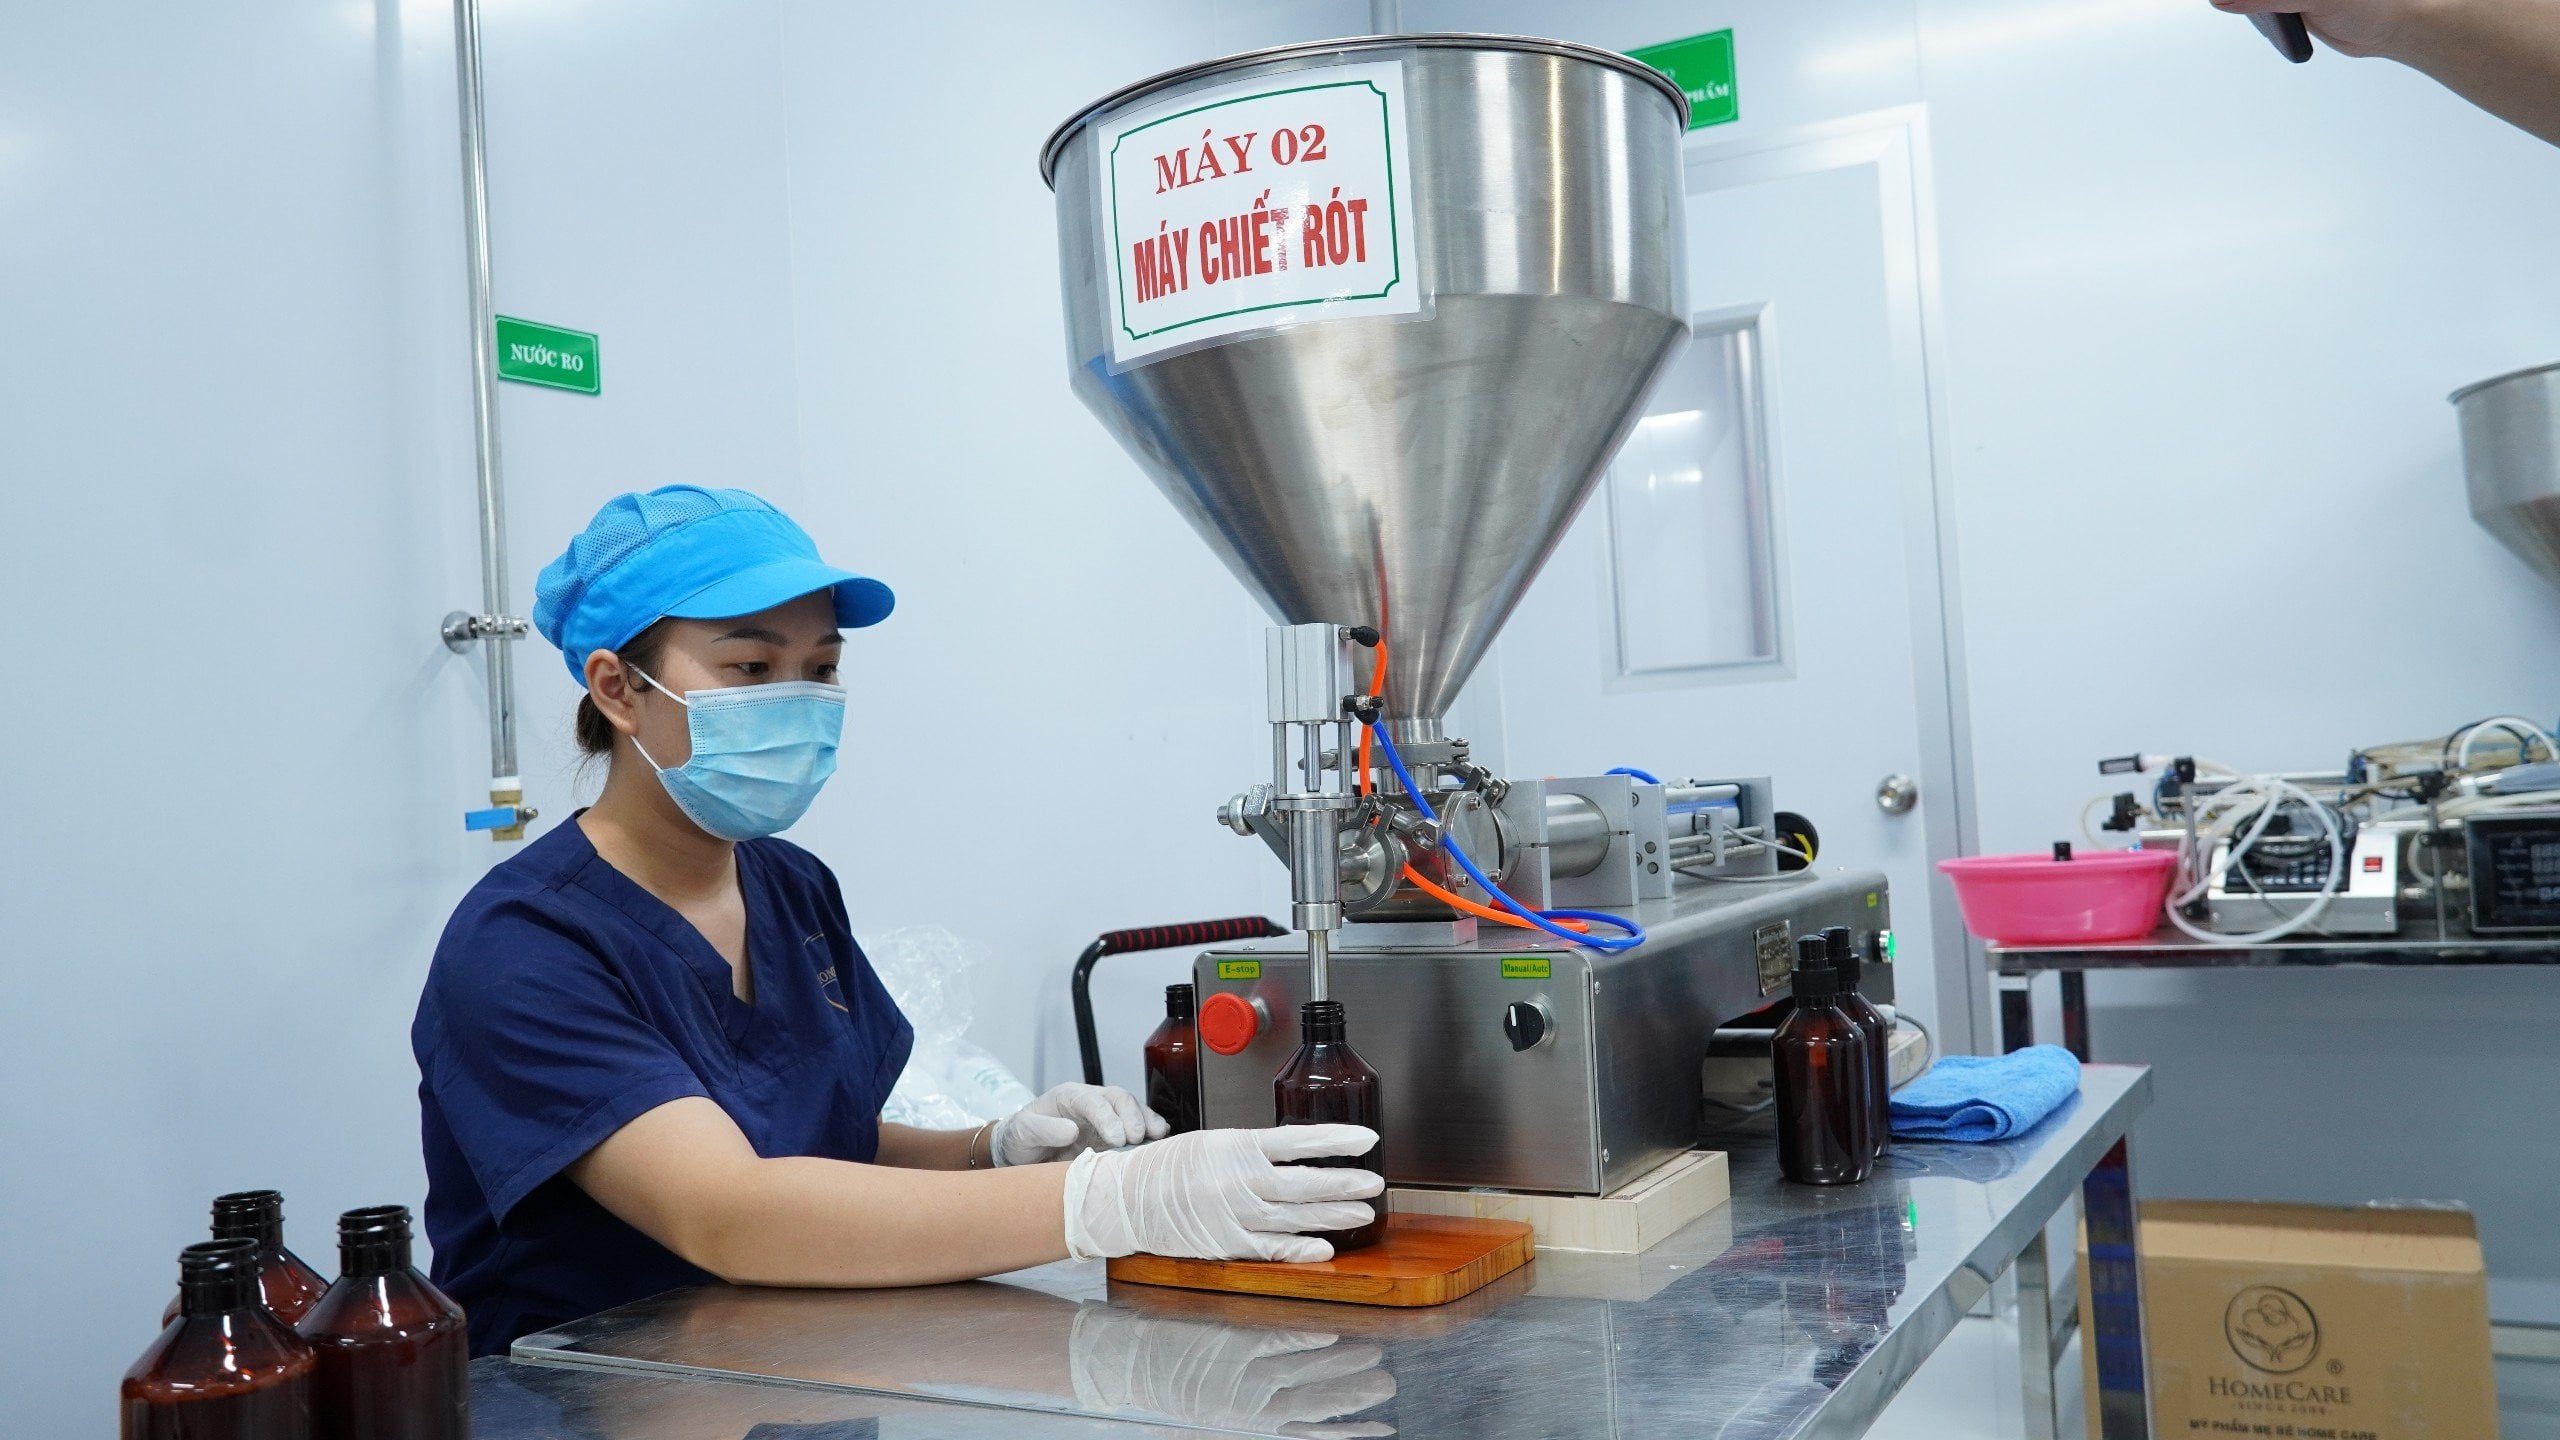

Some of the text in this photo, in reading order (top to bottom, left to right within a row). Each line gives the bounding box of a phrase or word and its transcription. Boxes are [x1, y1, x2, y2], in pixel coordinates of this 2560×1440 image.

[1154, 124, 1327, 194] MÁY 02
[1133, 186, 1368, 304] MÁY CHIẾT RÓT
[510, 343, 584, 372] NƯỚC RO
[1225, 964, 1256, 974] E-stop
